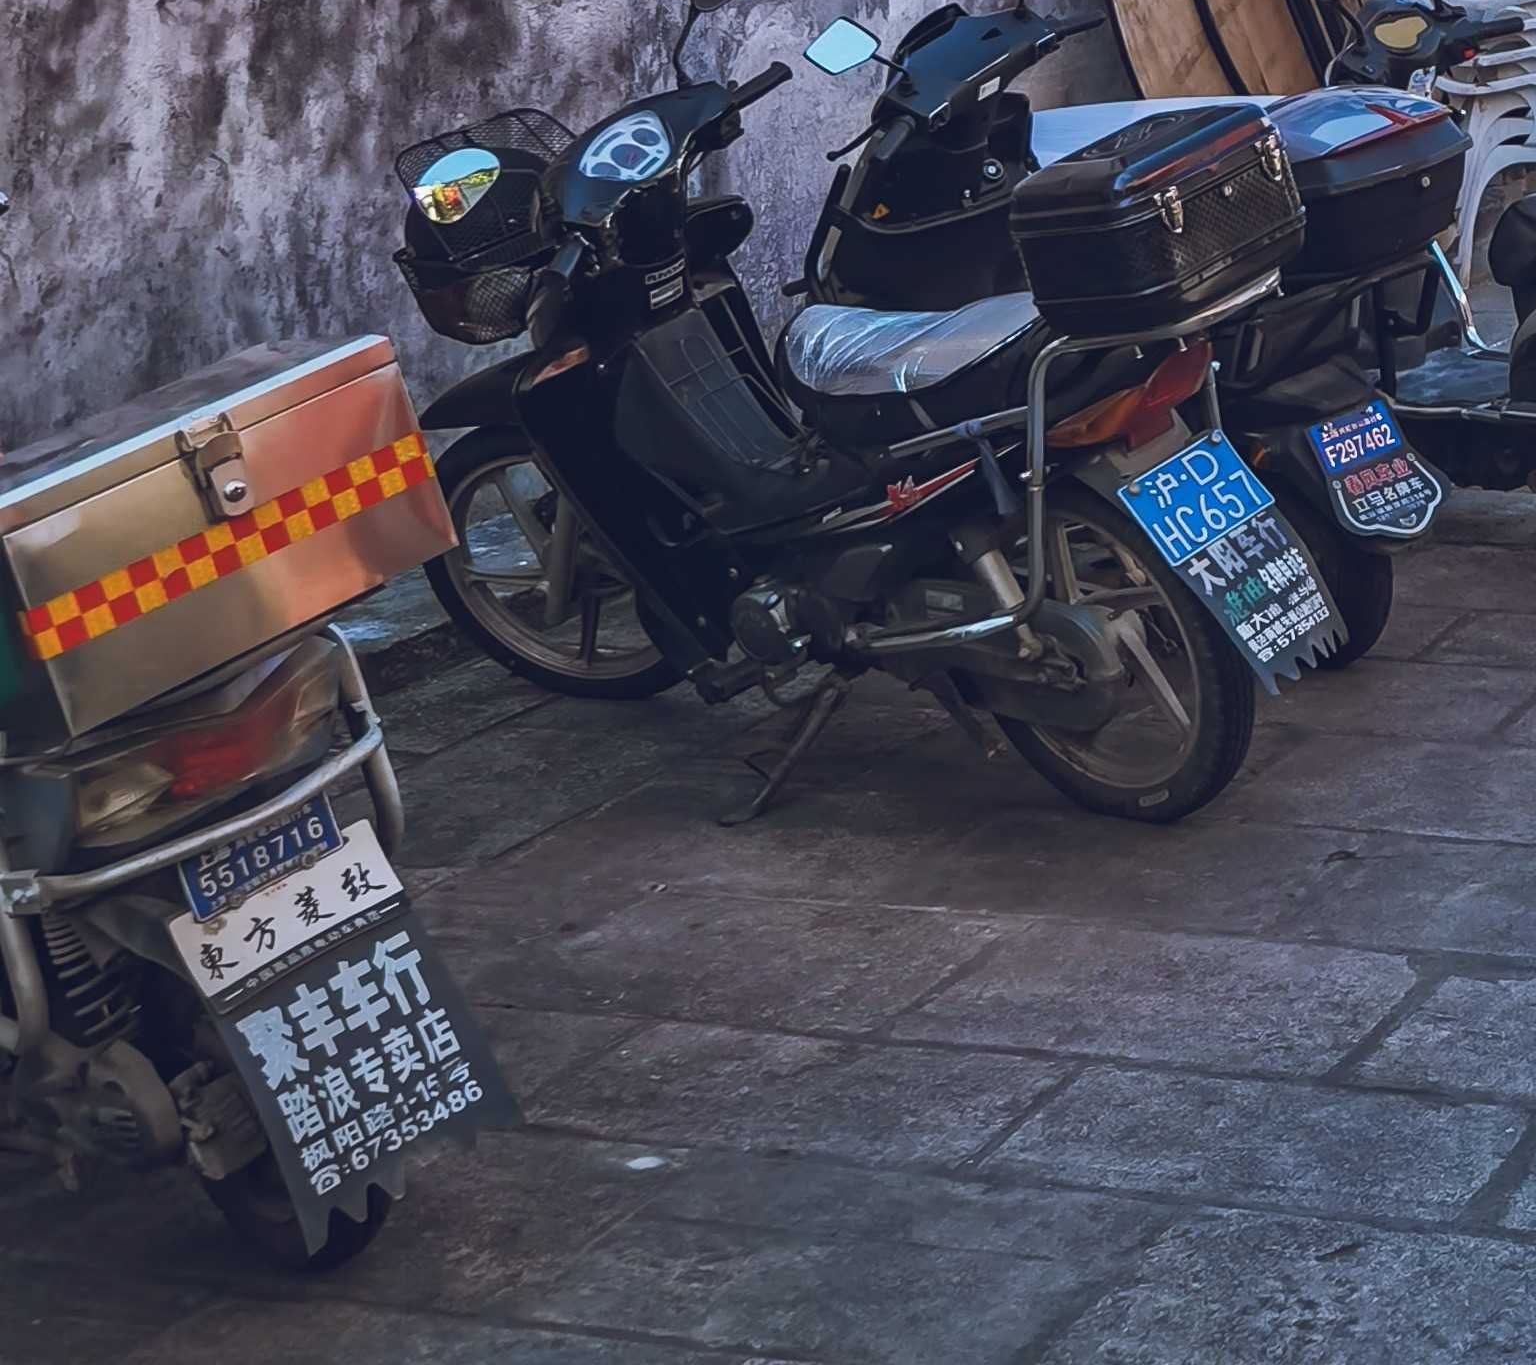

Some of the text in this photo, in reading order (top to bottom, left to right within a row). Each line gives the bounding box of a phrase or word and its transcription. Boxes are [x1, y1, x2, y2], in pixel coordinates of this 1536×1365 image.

[1145, 450, 1220, 508] 沪·D
[1324, 424, 1396, 467] F297462
[1152, 469, 1262, 558] HC657
[1352, 476, 1425, 512] 立马名牌车
[199, 817, 325, 897] 5518716
[235, 930, 431, 1091] 聚丰车行
[276, 1007, 461, 1144] 踏浪专卖店
